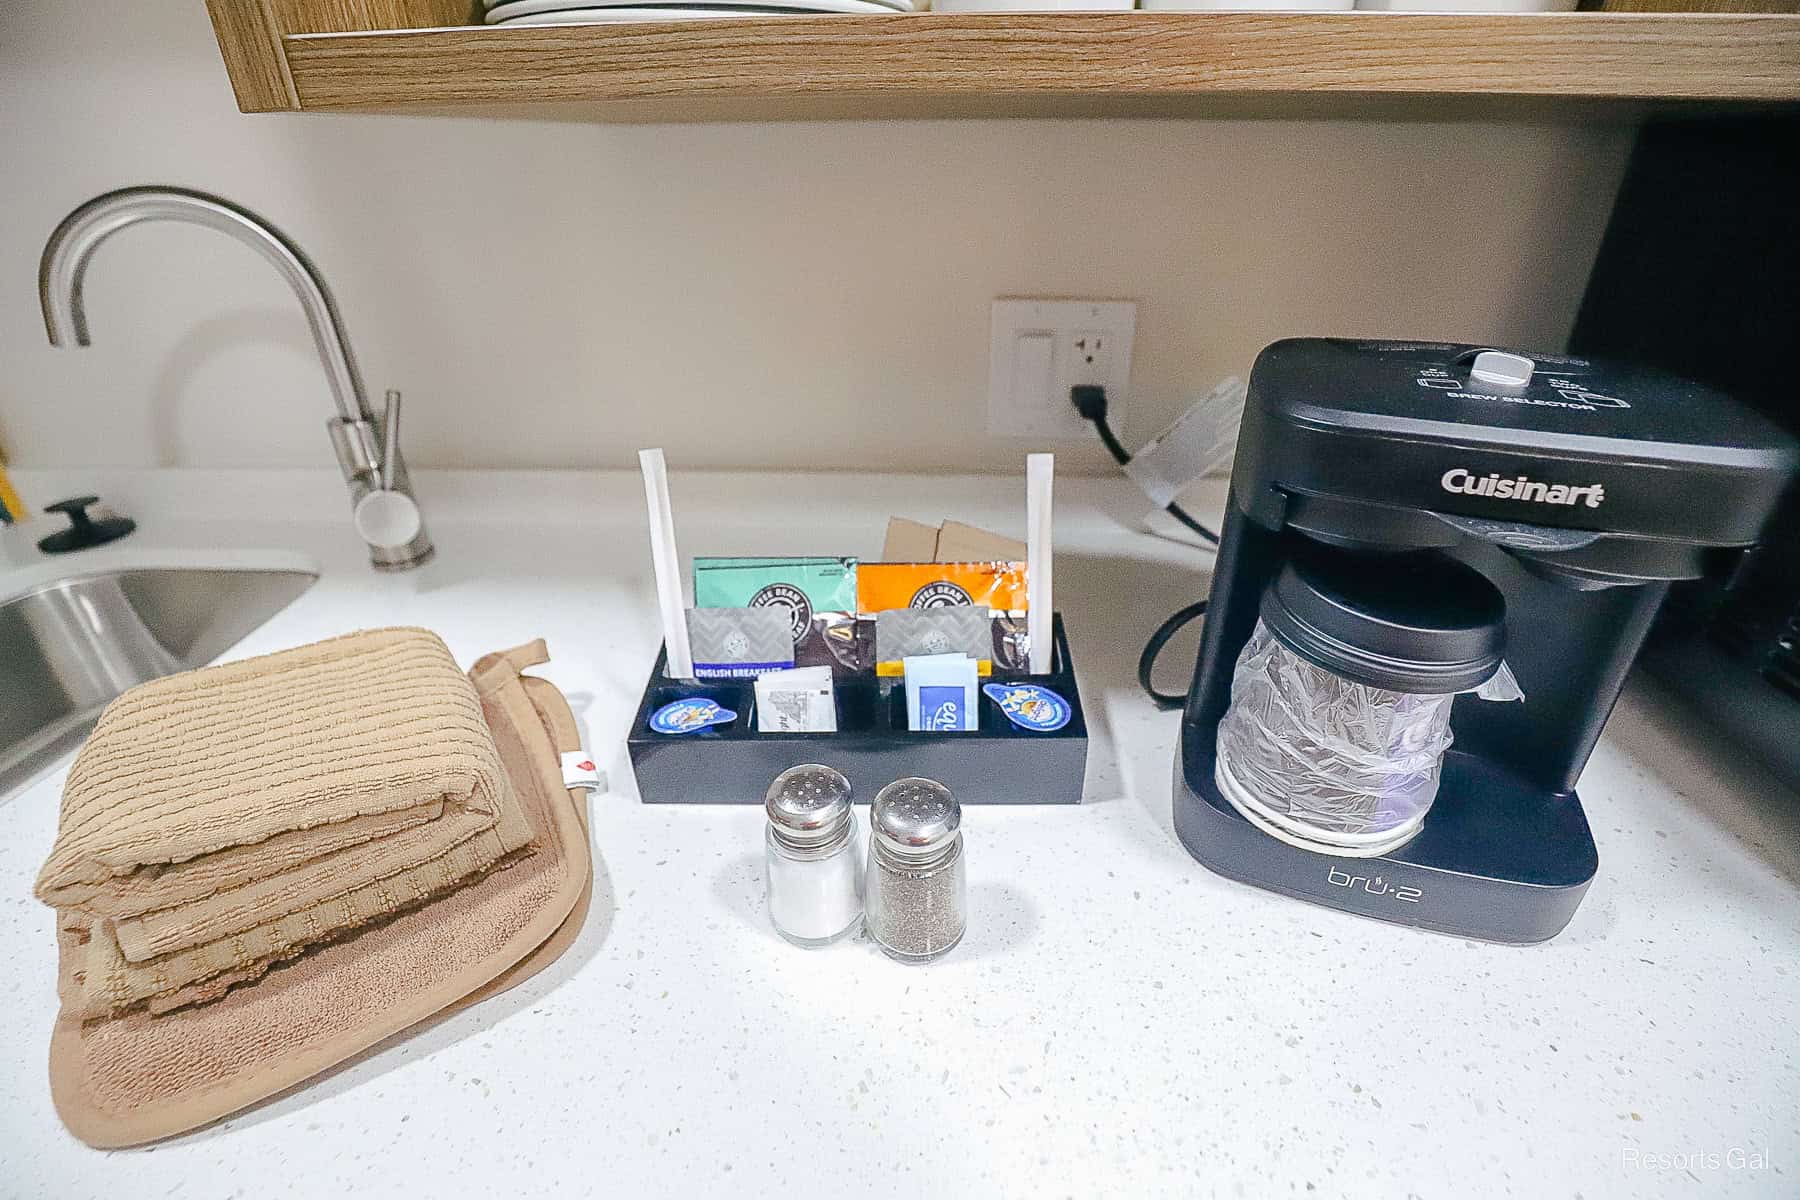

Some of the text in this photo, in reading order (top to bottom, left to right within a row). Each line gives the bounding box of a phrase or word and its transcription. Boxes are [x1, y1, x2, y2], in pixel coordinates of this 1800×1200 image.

[1446, 391, 1598, 411] BREW SELECTOR
[1441, 468, 1605, 509] Cuisinart
[775, 587, 801, 603] BEAN
[936, 585, 964, 601] BEAN
[695, 668, 731, 678] ENGLISH
